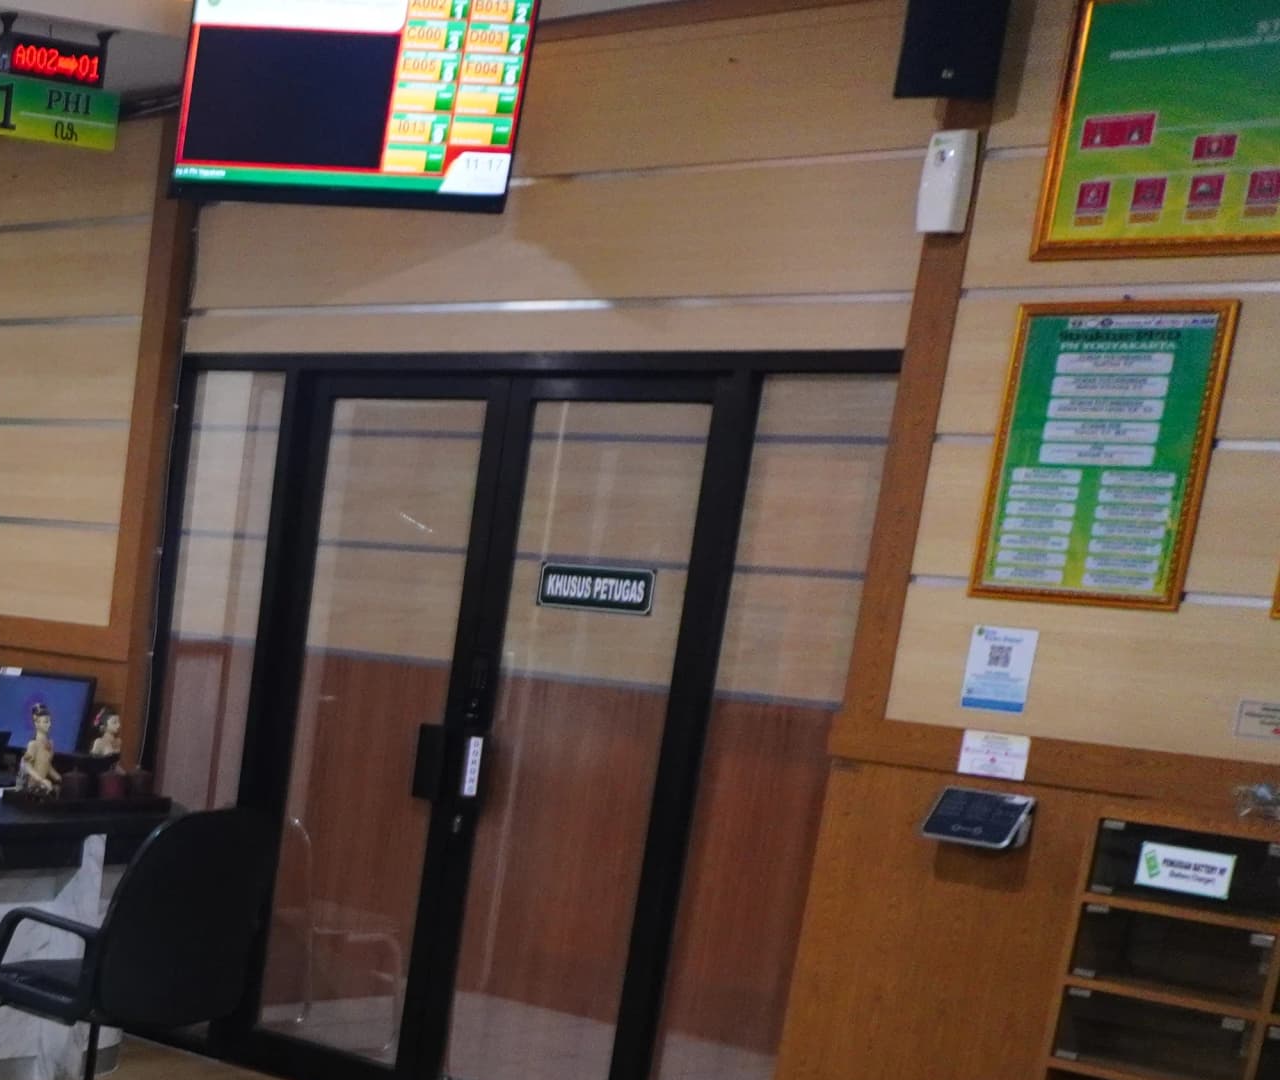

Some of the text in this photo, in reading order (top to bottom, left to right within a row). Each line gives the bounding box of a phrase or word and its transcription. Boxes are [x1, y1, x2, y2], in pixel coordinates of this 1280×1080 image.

[15, 44, 100, 81] A002 01
[46, 90, 91, 115] PHI
[546, 573, 645, 603] KHUSUS PETUGAS
